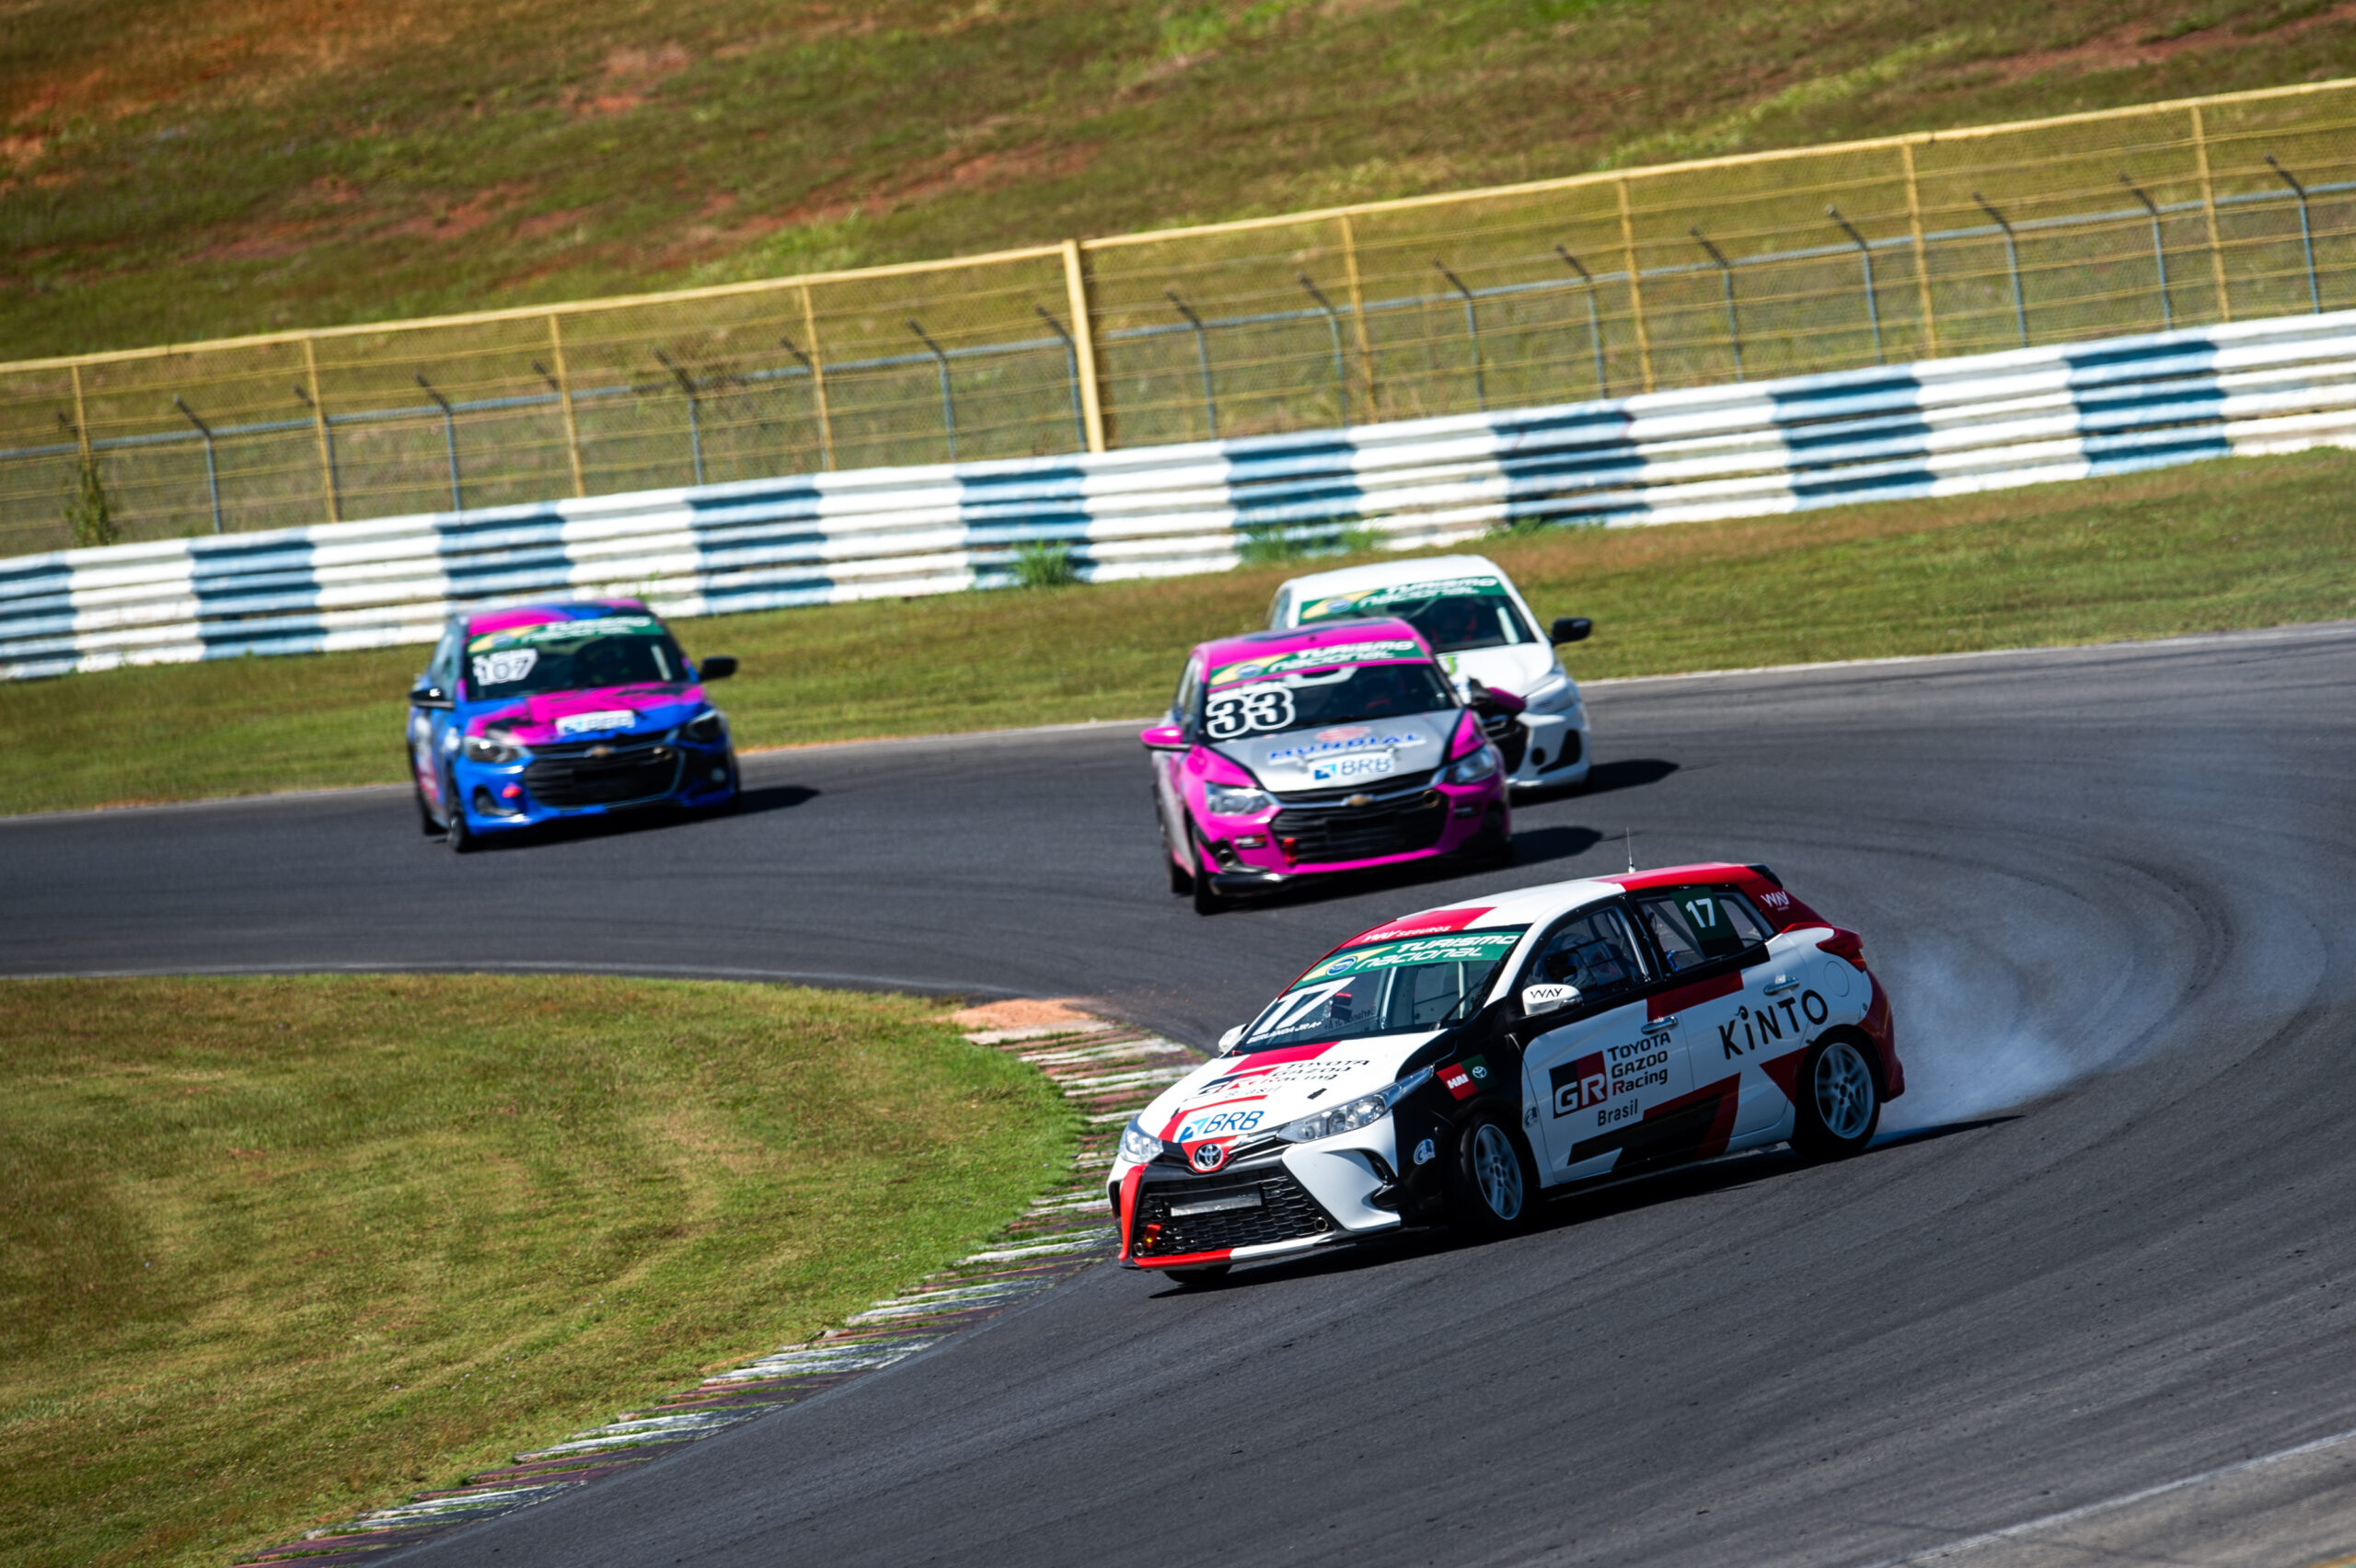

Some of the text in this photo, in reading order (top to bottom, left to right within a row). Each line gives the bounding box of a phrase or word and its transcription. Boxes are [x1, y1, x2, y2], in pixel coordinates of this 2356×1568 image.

[1206, 691, 1295, 738] 33
[1341, 758, 1391, 777] BRB
[1686, 897, 1716, 928] 17
[1396, 935, 1519, 953] TURISMO
[1252, 976, 1357, 1036] 17
[1530, 987, 1563, 999] WAY
[1607, 1032, 1671, 1061] TOYOTA
[1288, 1060, 1370, 1069] TOYOTA
[1611, 1050, 1669, 1079] GAZOO
[1554, 1073, 1607, 1115] GR
[1612, 1068, 1669, 1096] Racing
[1203, 1111, 1265, 1134] BRB
[1598, 1099, 1638, 1126] Brasil
